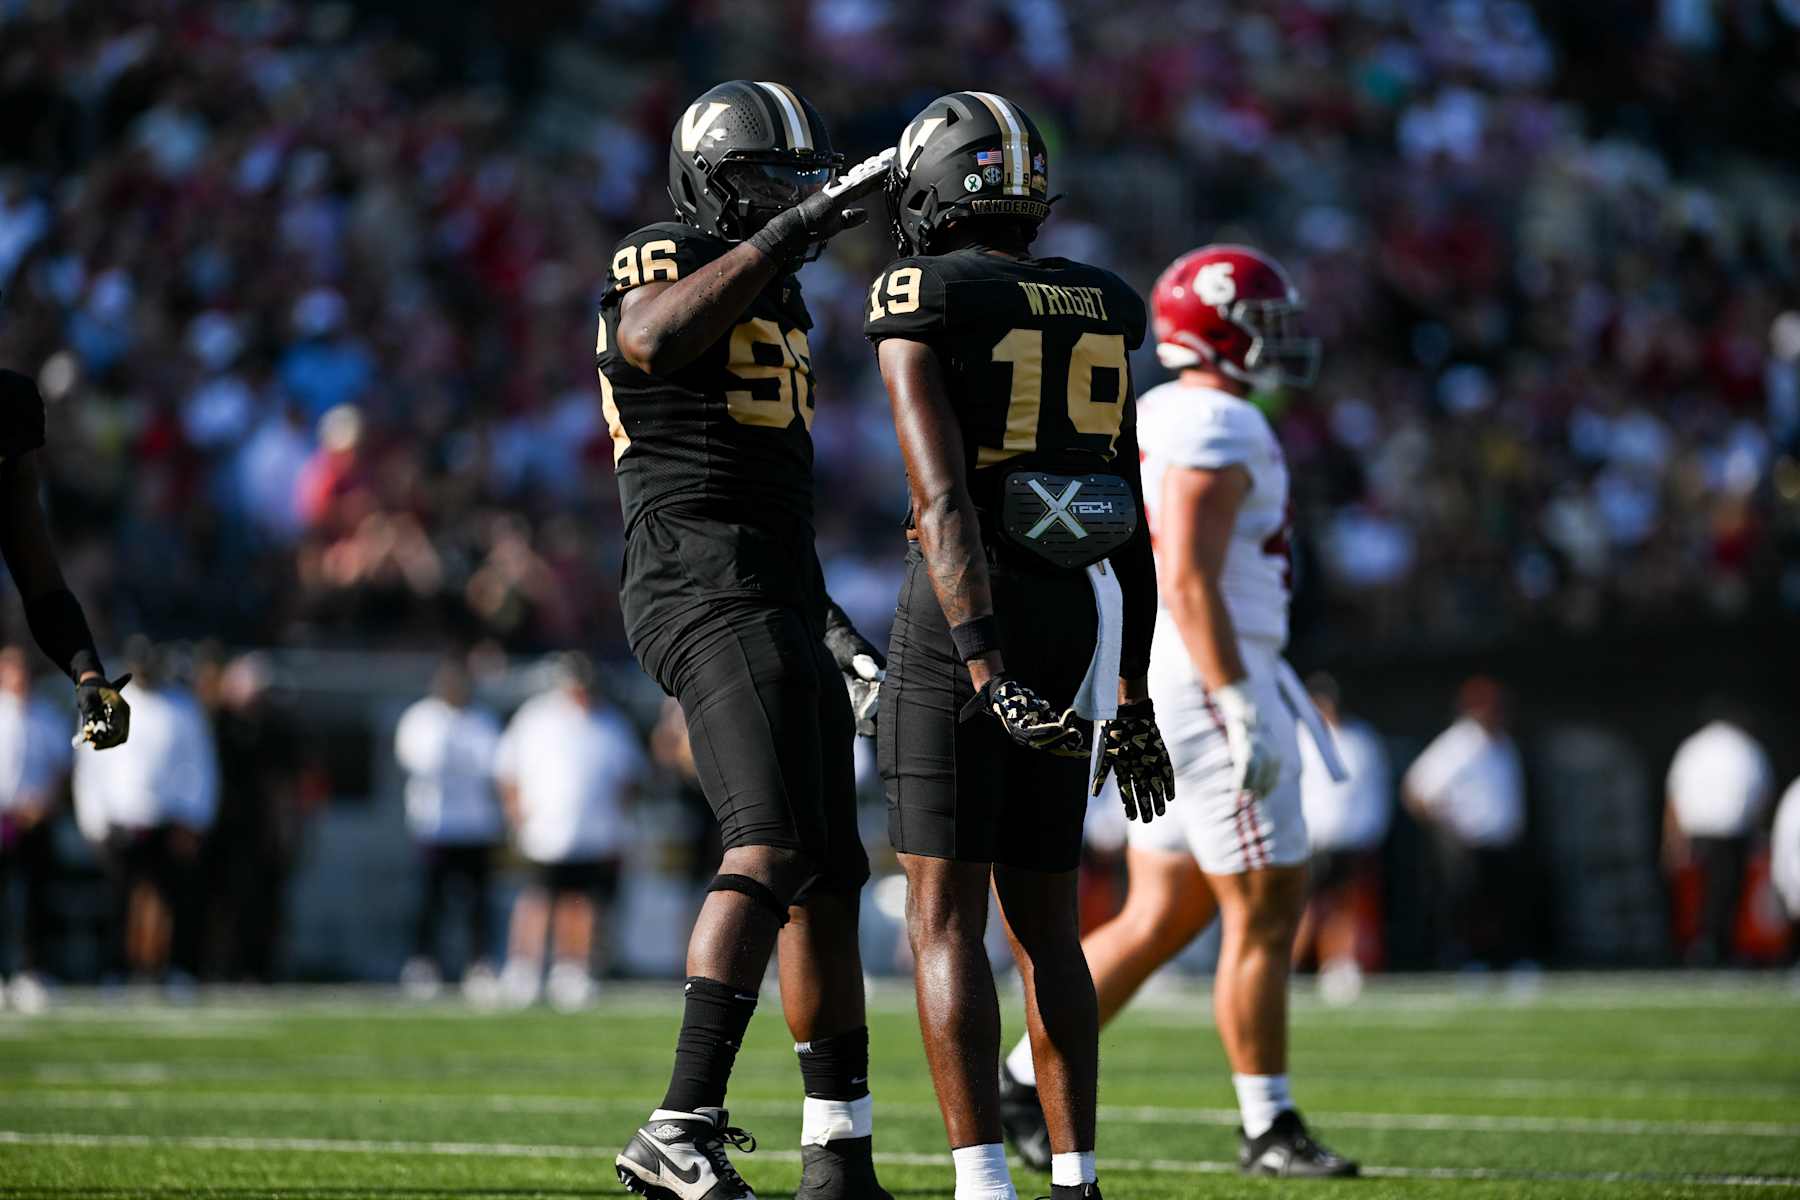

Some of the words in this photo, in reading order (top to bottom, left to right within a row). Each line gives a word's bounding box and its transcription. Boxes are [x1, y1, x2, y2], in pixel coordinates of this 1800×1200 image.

[681, 102, 731, 151] V
[612, 239, 679, 291] 96
[869, 267, 922, 322] 19
[1018, 281, 1108, 320] WRIGHT
[975, 329, 1128, 469] 19
